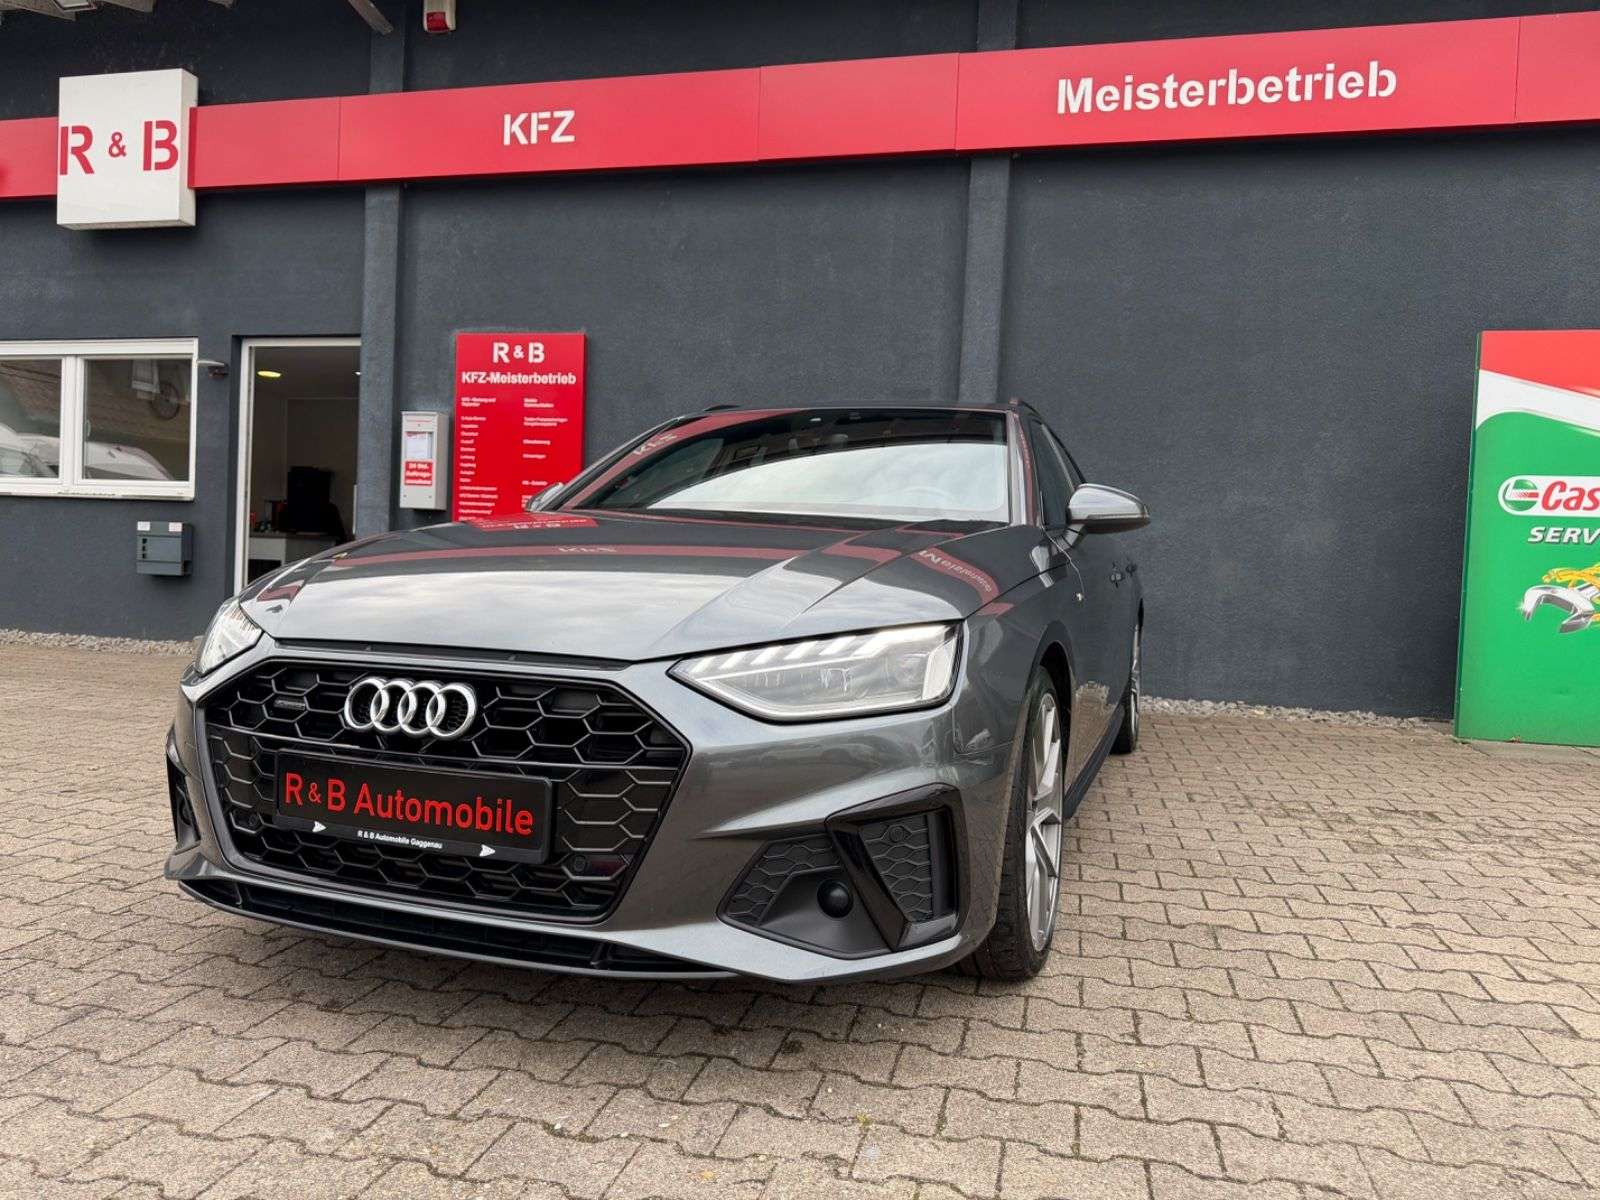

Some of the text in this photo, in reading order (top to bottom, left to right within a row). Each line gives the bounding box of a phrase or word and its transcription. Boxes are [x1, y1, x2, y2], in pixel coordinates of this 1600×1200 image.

[1056, 60, 1397, 115] Meisterbetrieb
[503, 109, 576, 147] KFZ
[59, 119, 179, 176] R & B
[492, 341, 545, 364] R & B
[461, 370, 577, 385] KFZ-Meisterbetrieb
[1541, 480, 1600, 512] Cas
[284, 770, 535, 836] R & B Automobile
[357, 830, 363, 838] R
[375, 833, 409, 844] Automobile
[411, 838, 443, 849] Gaggenau
